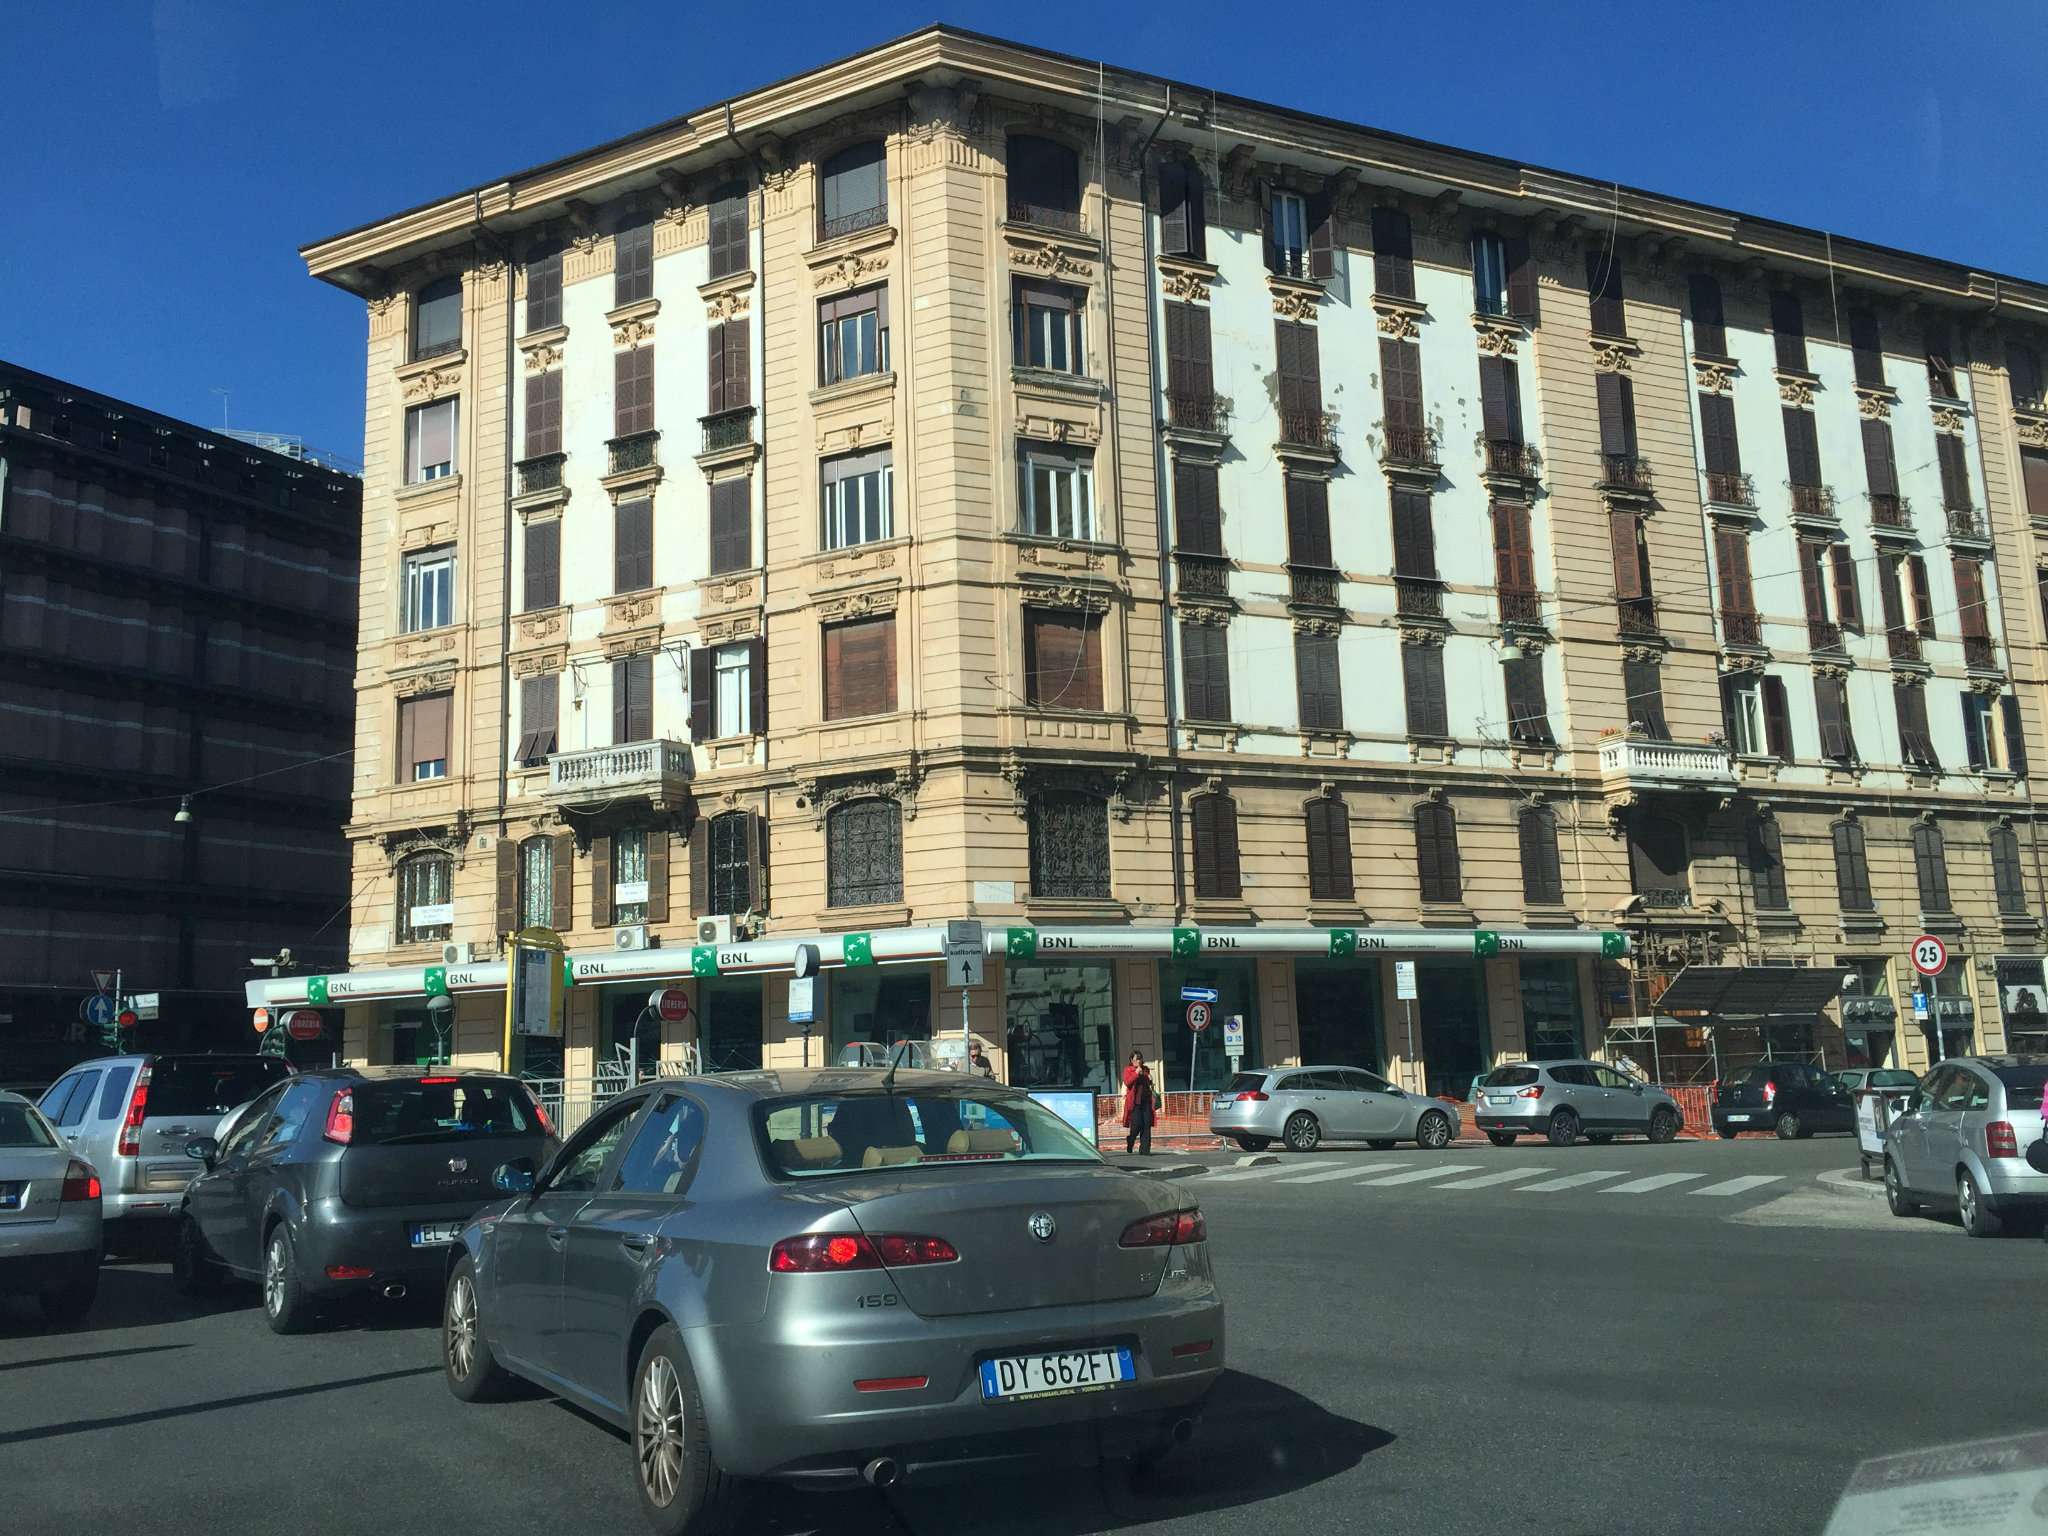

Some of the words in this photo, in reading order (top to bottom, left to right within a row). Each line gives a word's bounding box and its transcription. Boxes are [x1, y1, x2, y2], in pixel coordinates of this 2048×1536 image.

[1042, 936, 1078, 948] BNL
[1207, 936, 1240, 948] BNL
[1358, 937, 1389, 948] BNL
[1499, 938, 1527, 949] BNL
[721, 952, 753, 965] BNL
[1919, 947, 1938, 963] 25
[579, 963, 609, 975] BNL
[450, 973, 477, 985] BNL
[330, 982, 356, 993] BNL
[1193, 1010, 1205, 1022] 25
[423, 1225, 443, 1242] EL
[856, 1294, 897, 1309] 159
[999, 1357, 1030, 1392] DY
[1041, 1349, 1116, 1386] 662FT
